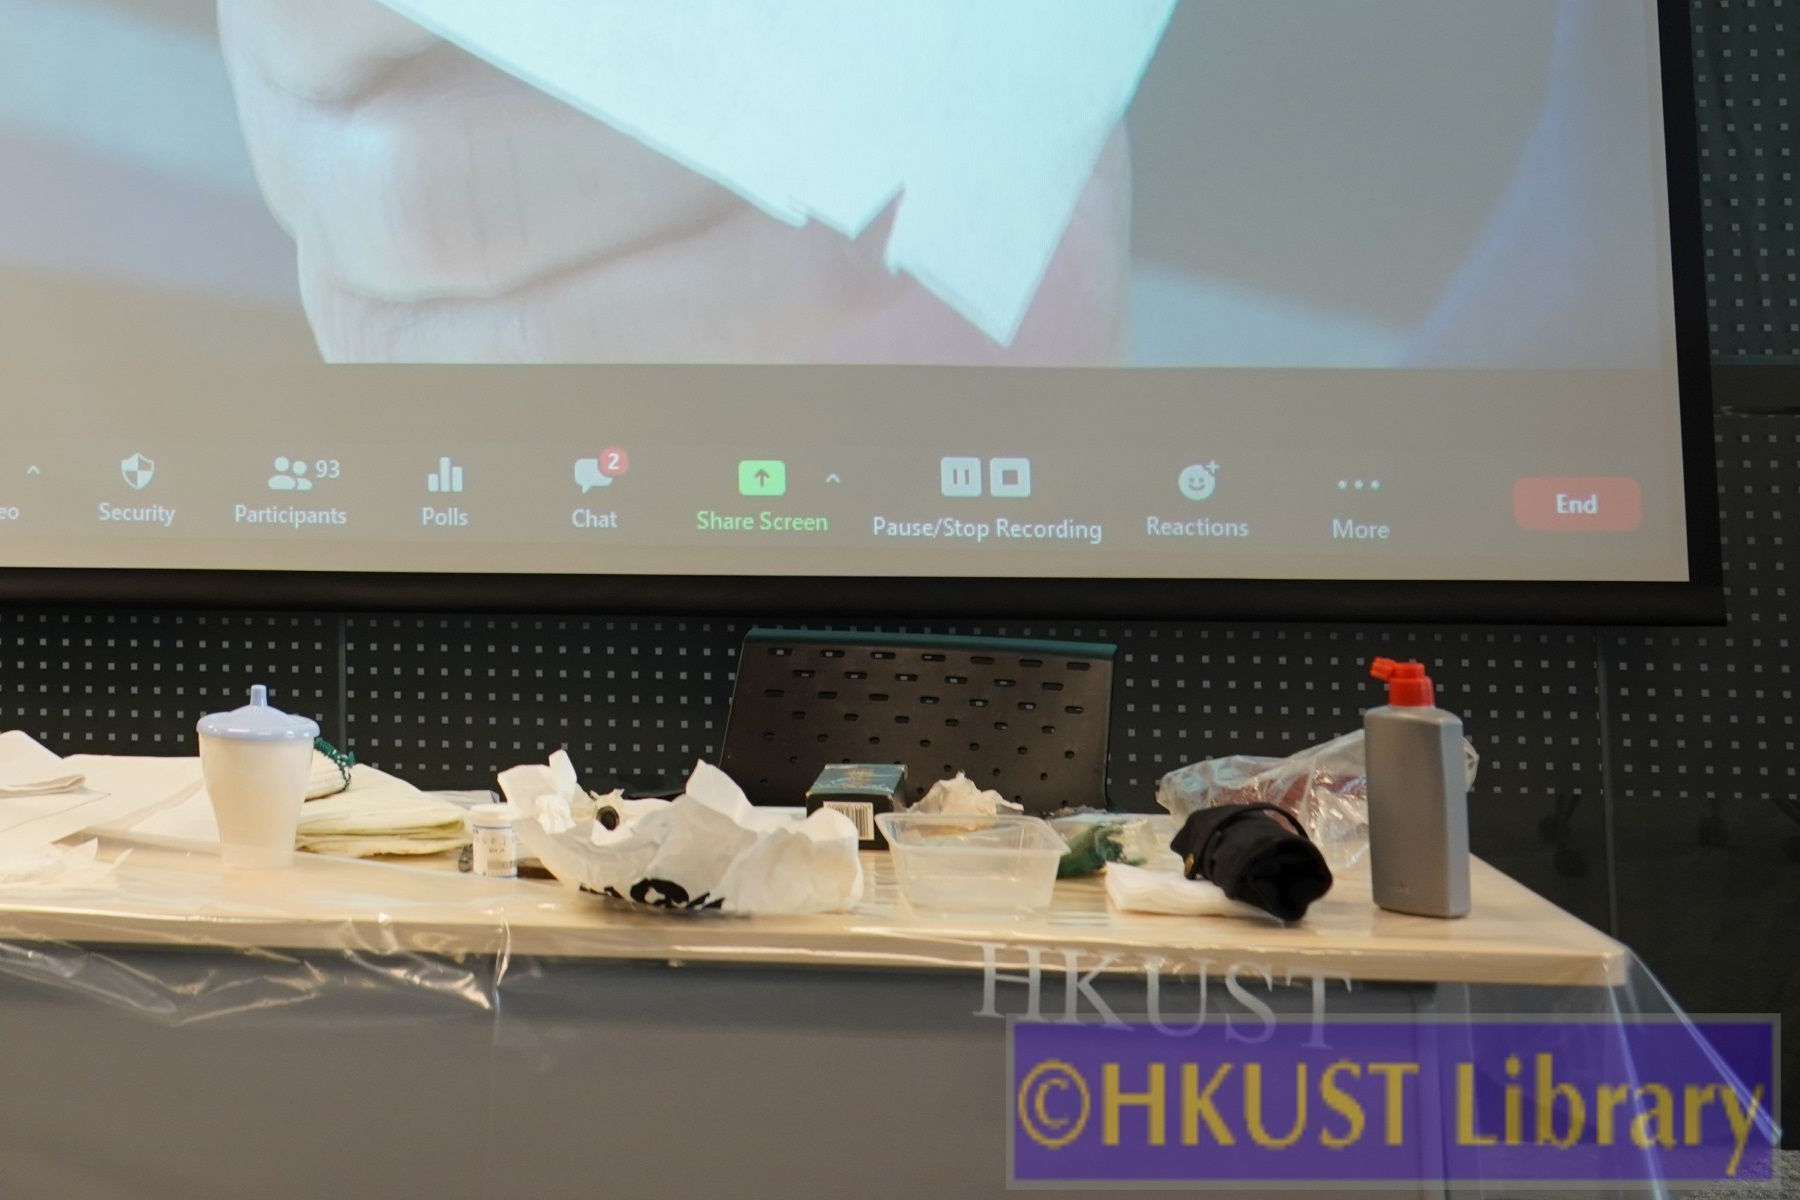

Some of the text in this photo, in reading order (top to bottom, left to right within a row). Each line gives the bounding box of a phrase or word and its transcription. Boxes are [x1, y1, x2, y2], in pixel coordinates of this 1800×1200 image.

[315, 461, 341, 478] 93
[607, 453, 620, 470] 2
[99, 502, 176, 526] Security
[1556, 495, 1598, 514] End
[234, 504, 347, 529] Participants
[421, 507, 469, 527] Polls
[571, 508, 618, 528] Chat
[696, 511, 829, 532] Share Screen
[873, 516, 1102, 544] Pause/Stop Recording
[1146, 517, 1249, 538] Reactions
[1332, 520, 1390, 540] More
